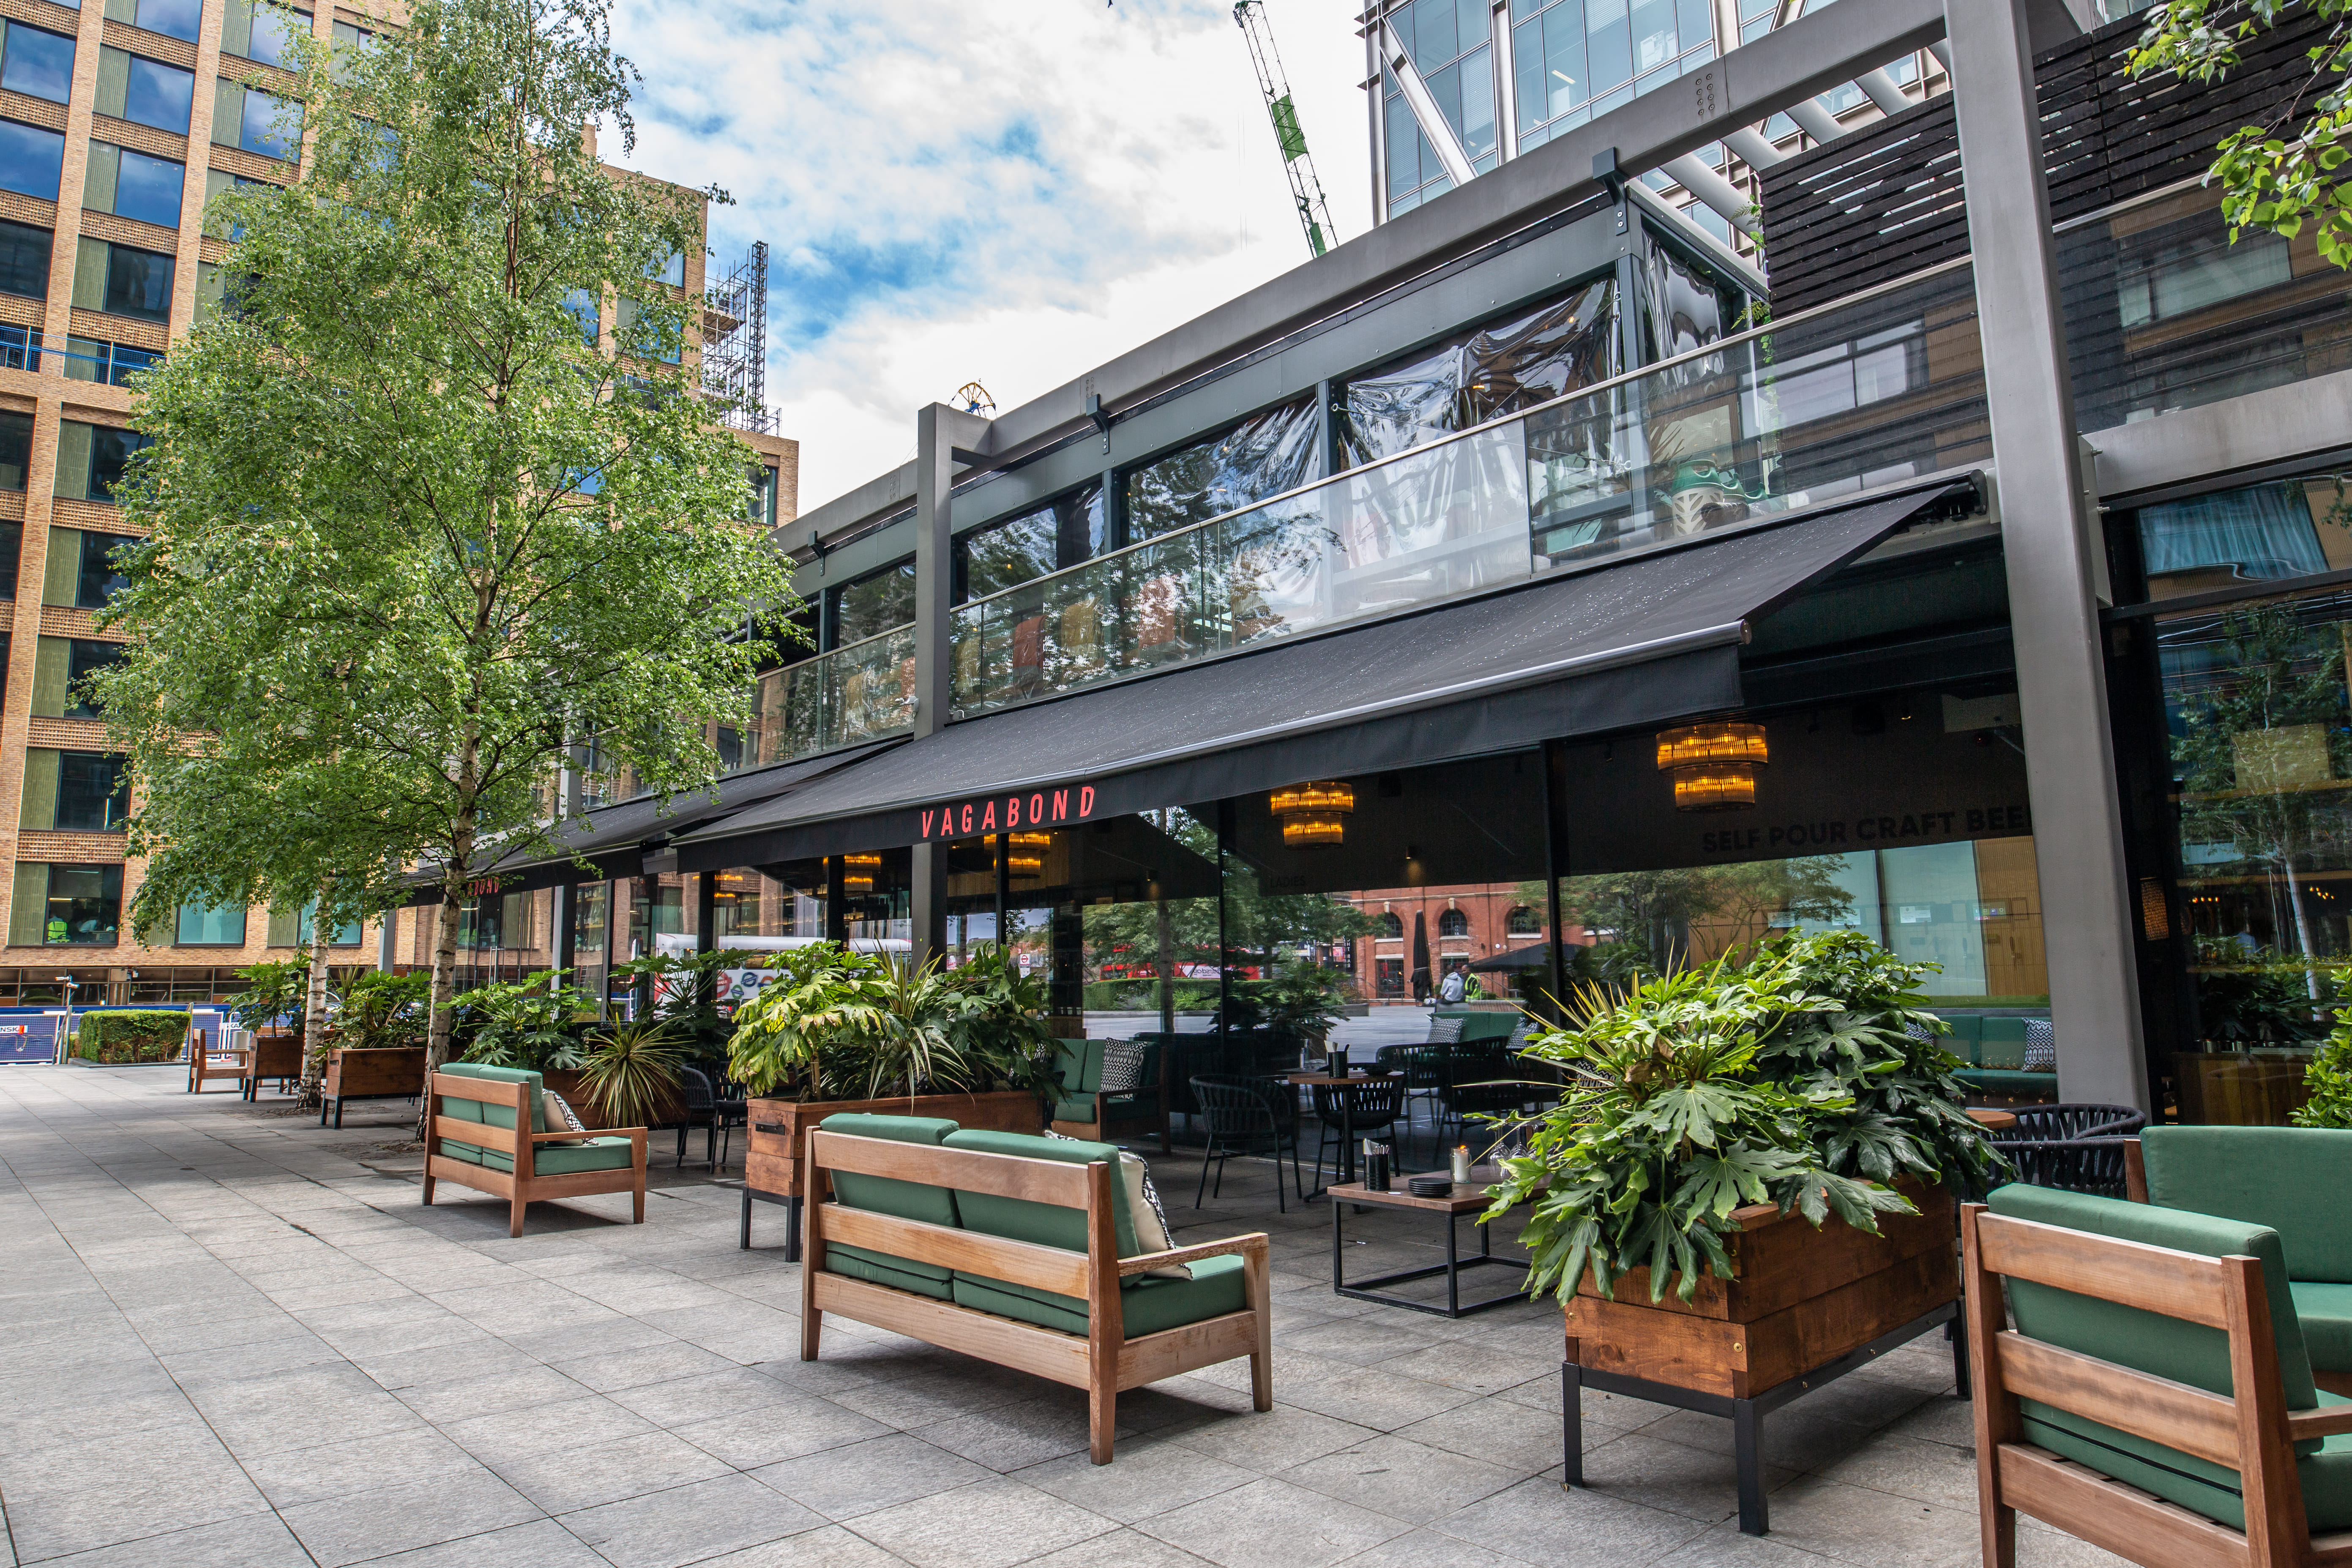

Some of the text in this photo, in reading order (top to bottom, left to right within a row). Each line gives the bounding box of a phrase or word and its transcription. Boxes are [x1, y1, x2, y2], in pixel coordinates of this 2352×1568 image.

[922, 786, 1095, 838] VAGABOND
[1703, 827, 1761, 853] SELF
[1769, 821, 1848, 846] POUR
[1857, 811, 1956, 841] CRAFT
[467, 877, 499, 896] ABOND
